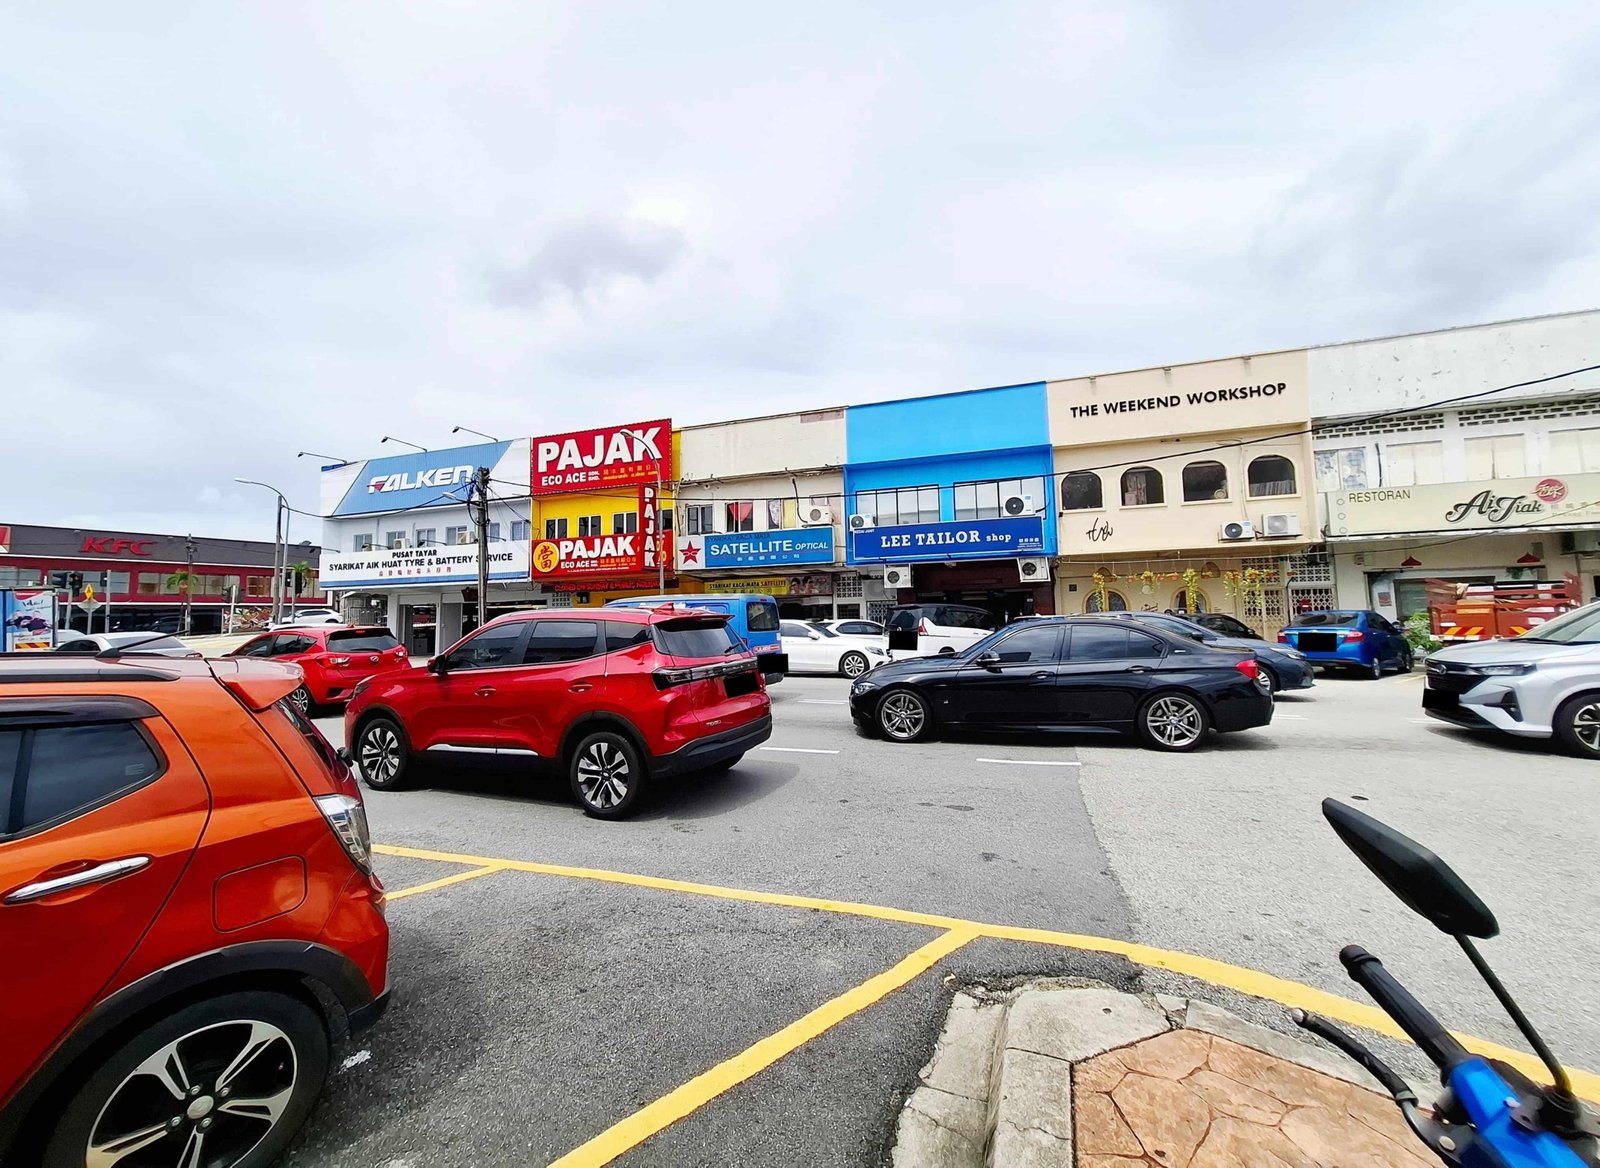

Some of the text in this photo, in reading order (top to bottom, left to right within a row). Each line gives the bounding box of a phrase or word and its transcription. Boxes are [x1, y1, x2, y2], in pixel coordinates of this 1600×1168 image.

[1070, 382, 1287, 419] THE WEEKEND WORKSHOP
[538, 427, 663, 473] PAJAK
[367, 465, 474, 495] FALKEN
[541, 474, 562, 486] ECO
[565, 472, 587, 484] ACE
[1348, 489, 1411, 503] RESTORAN
[643, 487, 656, 567] PAJAK
[80, 536, 157, 556] KFC
[560, 536, 635, 560] PAJAK
[710, 540, 828, 555] SATELLITE OPTICAL
[881, 530, 1011, 548] LEE TAILOR shop
[329, 552, 513, 571] SYARIKAT AIK HUAT TYRE & BATTERY SRVICE
[392, 549, 437, 558] PUSAT TAYAR
[561, 561, 574, 569] ECO
[576, 560, 590, 568] ACE
